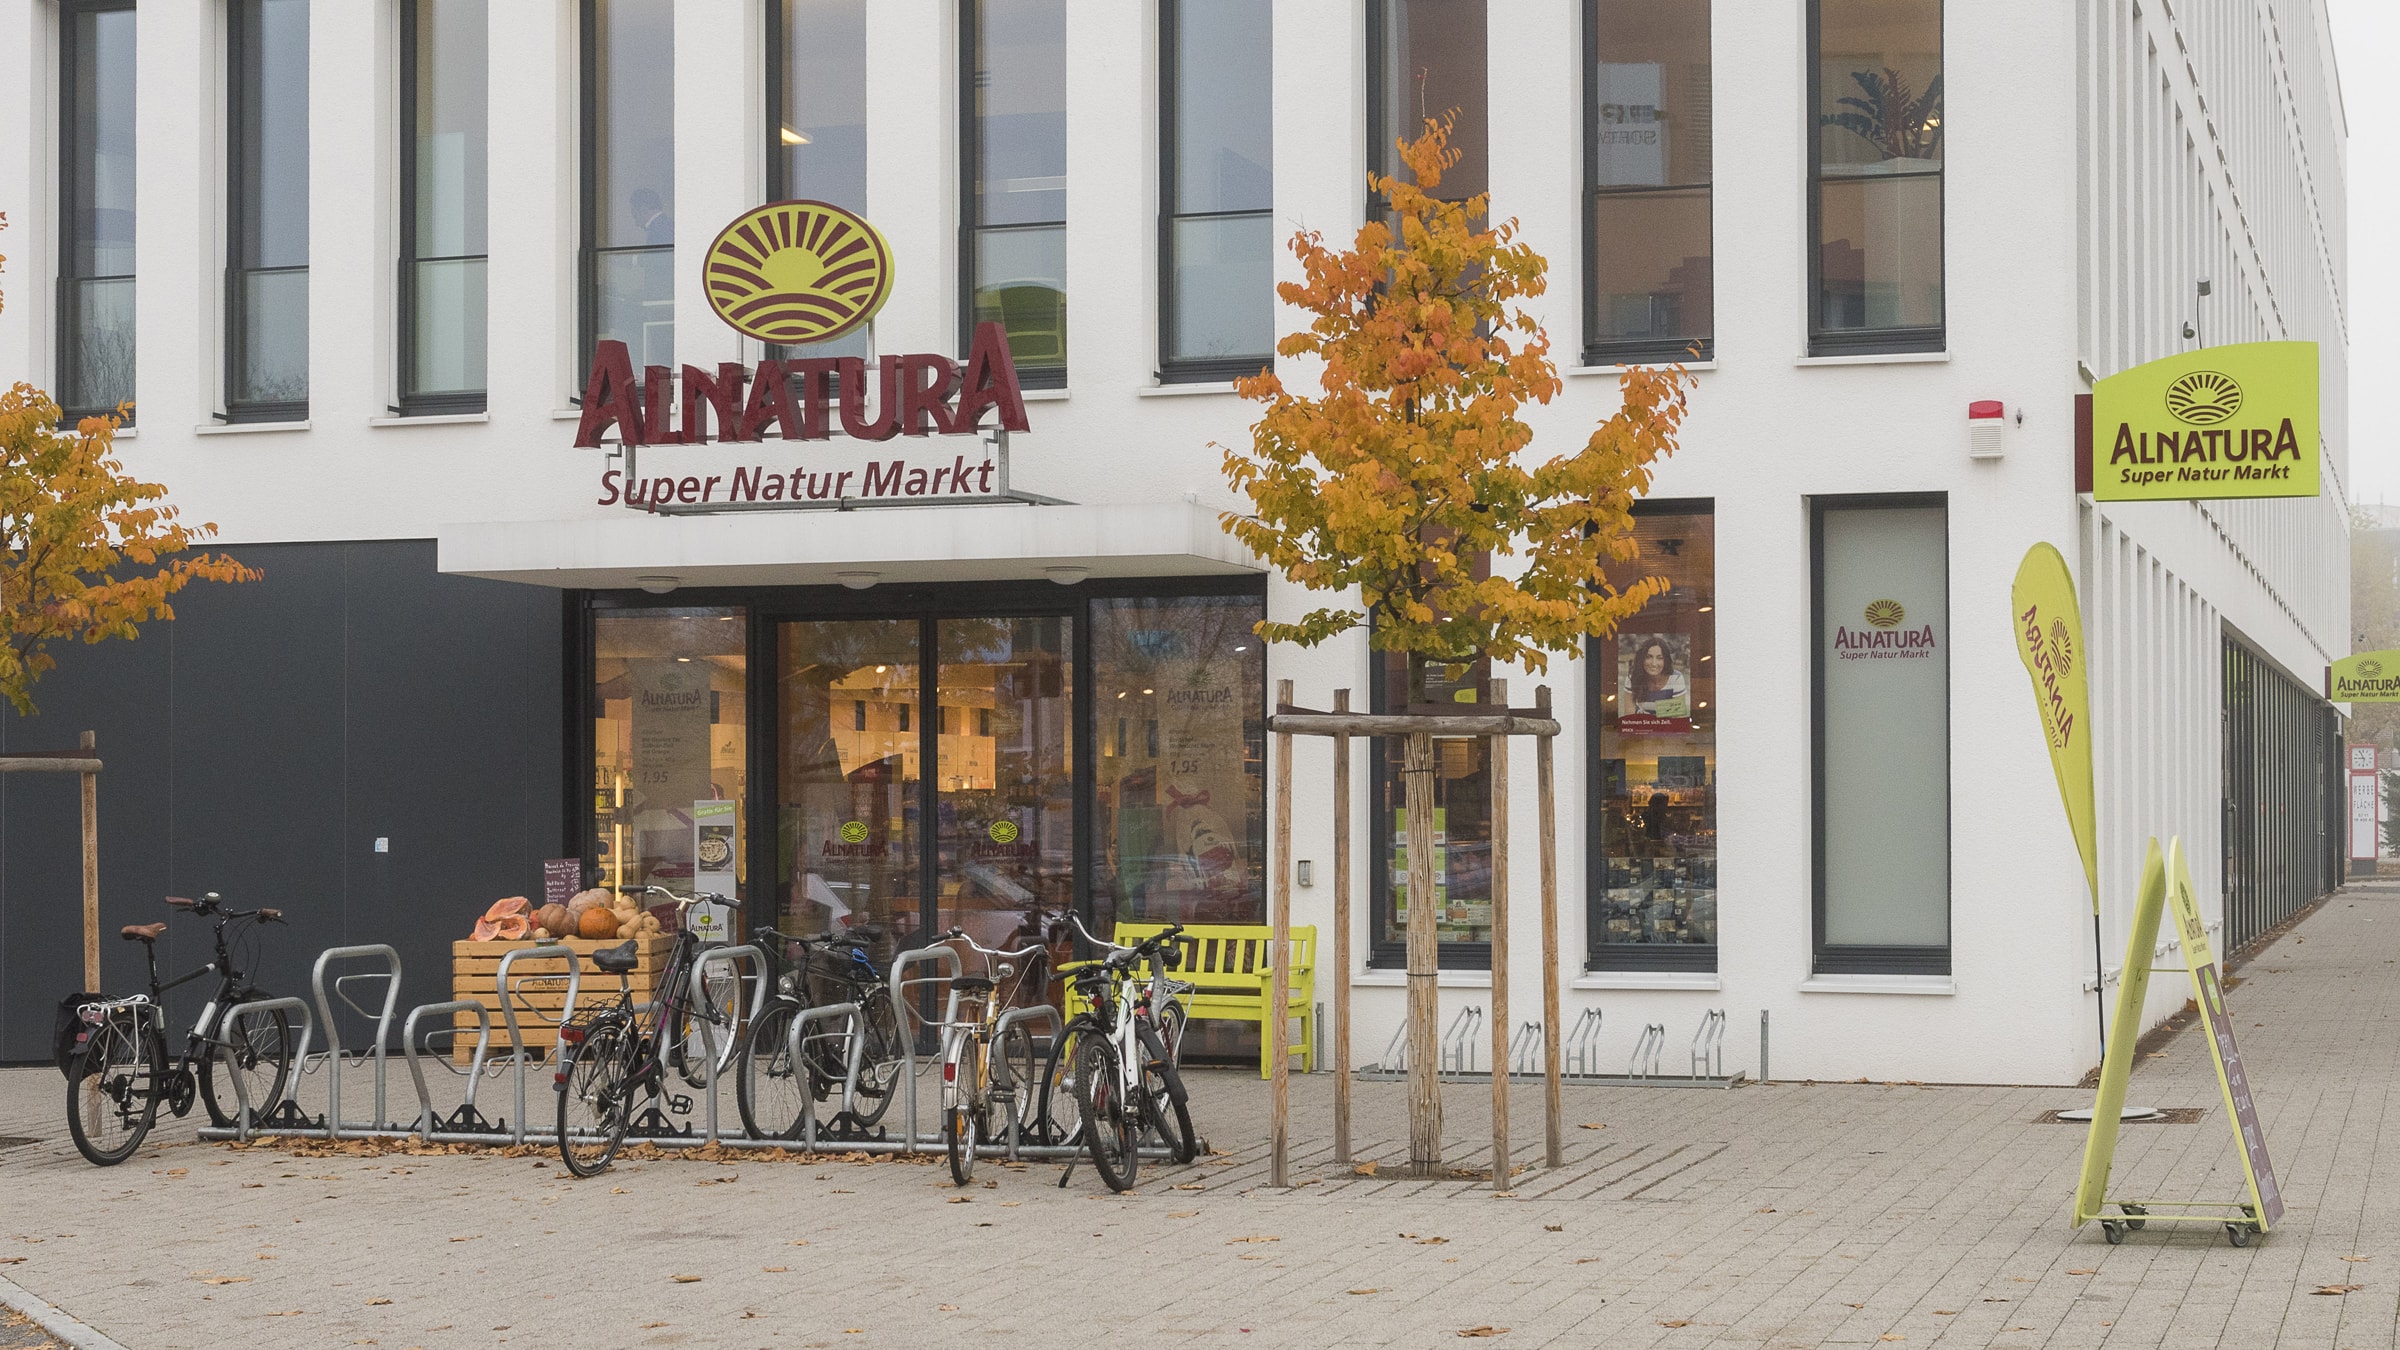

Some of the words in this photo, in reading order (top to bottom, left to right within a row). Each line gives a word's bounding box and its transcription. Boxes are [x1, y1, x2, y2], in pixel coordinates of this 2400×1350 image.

[573, 321, 1031, 449] ALNATURA
[2110, 417, 2301, 465] ALNATURA
[2120, 468, 2173, 486] Super
[2177, 466, 2231, 482] Natur
[2234, 464, 2290, 480] Markt
[597, 470, 721, 514] Super
[729, 465, 853, 502] Natur
[861, 455, 995, 497] Markt
[1834, 624, 1936, 649] ALNATURA
[1840, 650, 1868, 661] Super
[1870, 650, 1898, 659] Natur
[1900, 649, 1930, 659] Markt
[2337, 675, 2400, 691] ALNATURA
[641, 688, 701, 706] ALNATURA
[1167, 686, 1233, 704] ALNATURA
[2340, 691, 2359, 699] Super
[1170, 760, 1198, 775] 1,95
[643, 770, 668, 784] 1,95
[821, 840, 889, 856] ALNATURA
